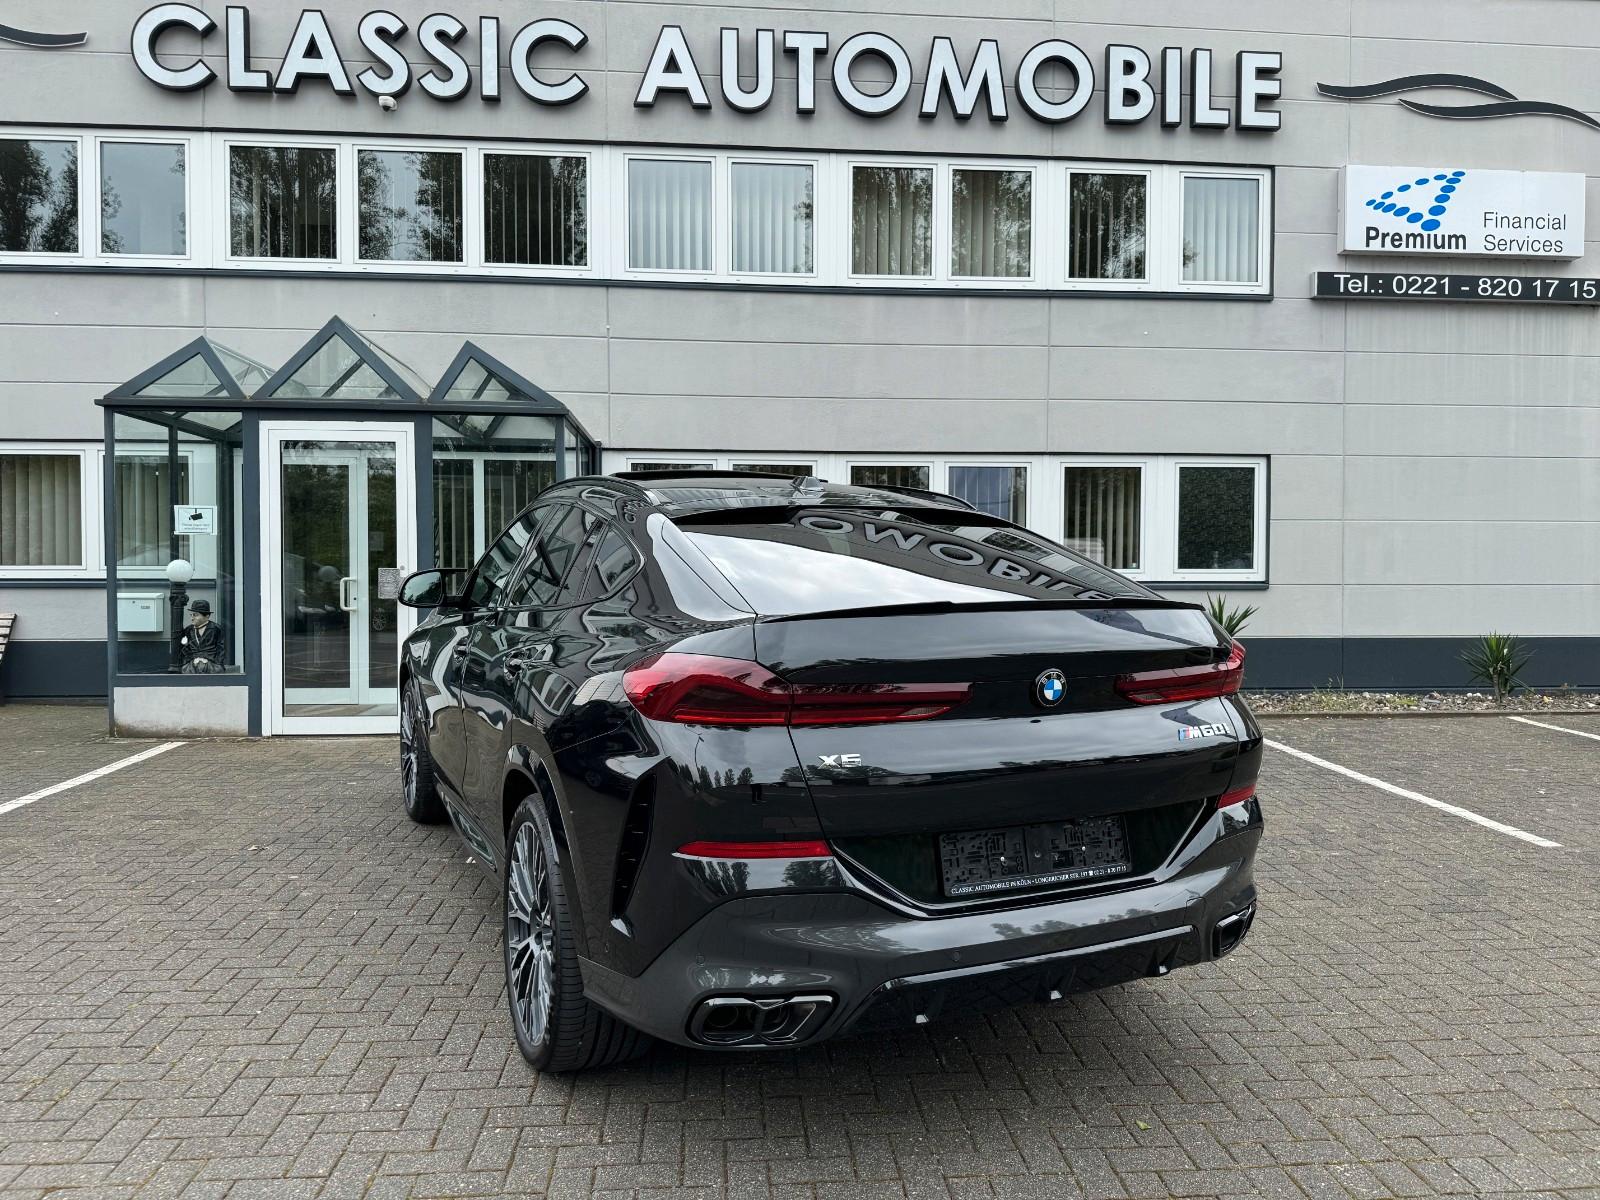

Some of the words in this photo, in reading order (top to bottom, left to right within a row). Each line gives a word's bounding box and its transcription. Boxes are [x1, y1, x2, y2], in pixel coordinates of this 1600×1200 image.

[131, 2, 590, 106] CLASSIC
[634, 24, 1282, 132] AUTOMOBILE
[1483, 211, 1567, 231] Financial
[1365, 226, 1467, 250] Premium
[1483, 234, 1564, 253] Services
[1333, 274, 1383, 294] Tel.:
[1392, 276, 1450, 295] 0221
[1478, 278, 1522, 297] 820
[1532, 279, 1560, 298] 17
[1568, 280, 1597, 299] 15
[818, 753, 862, 770] X6
